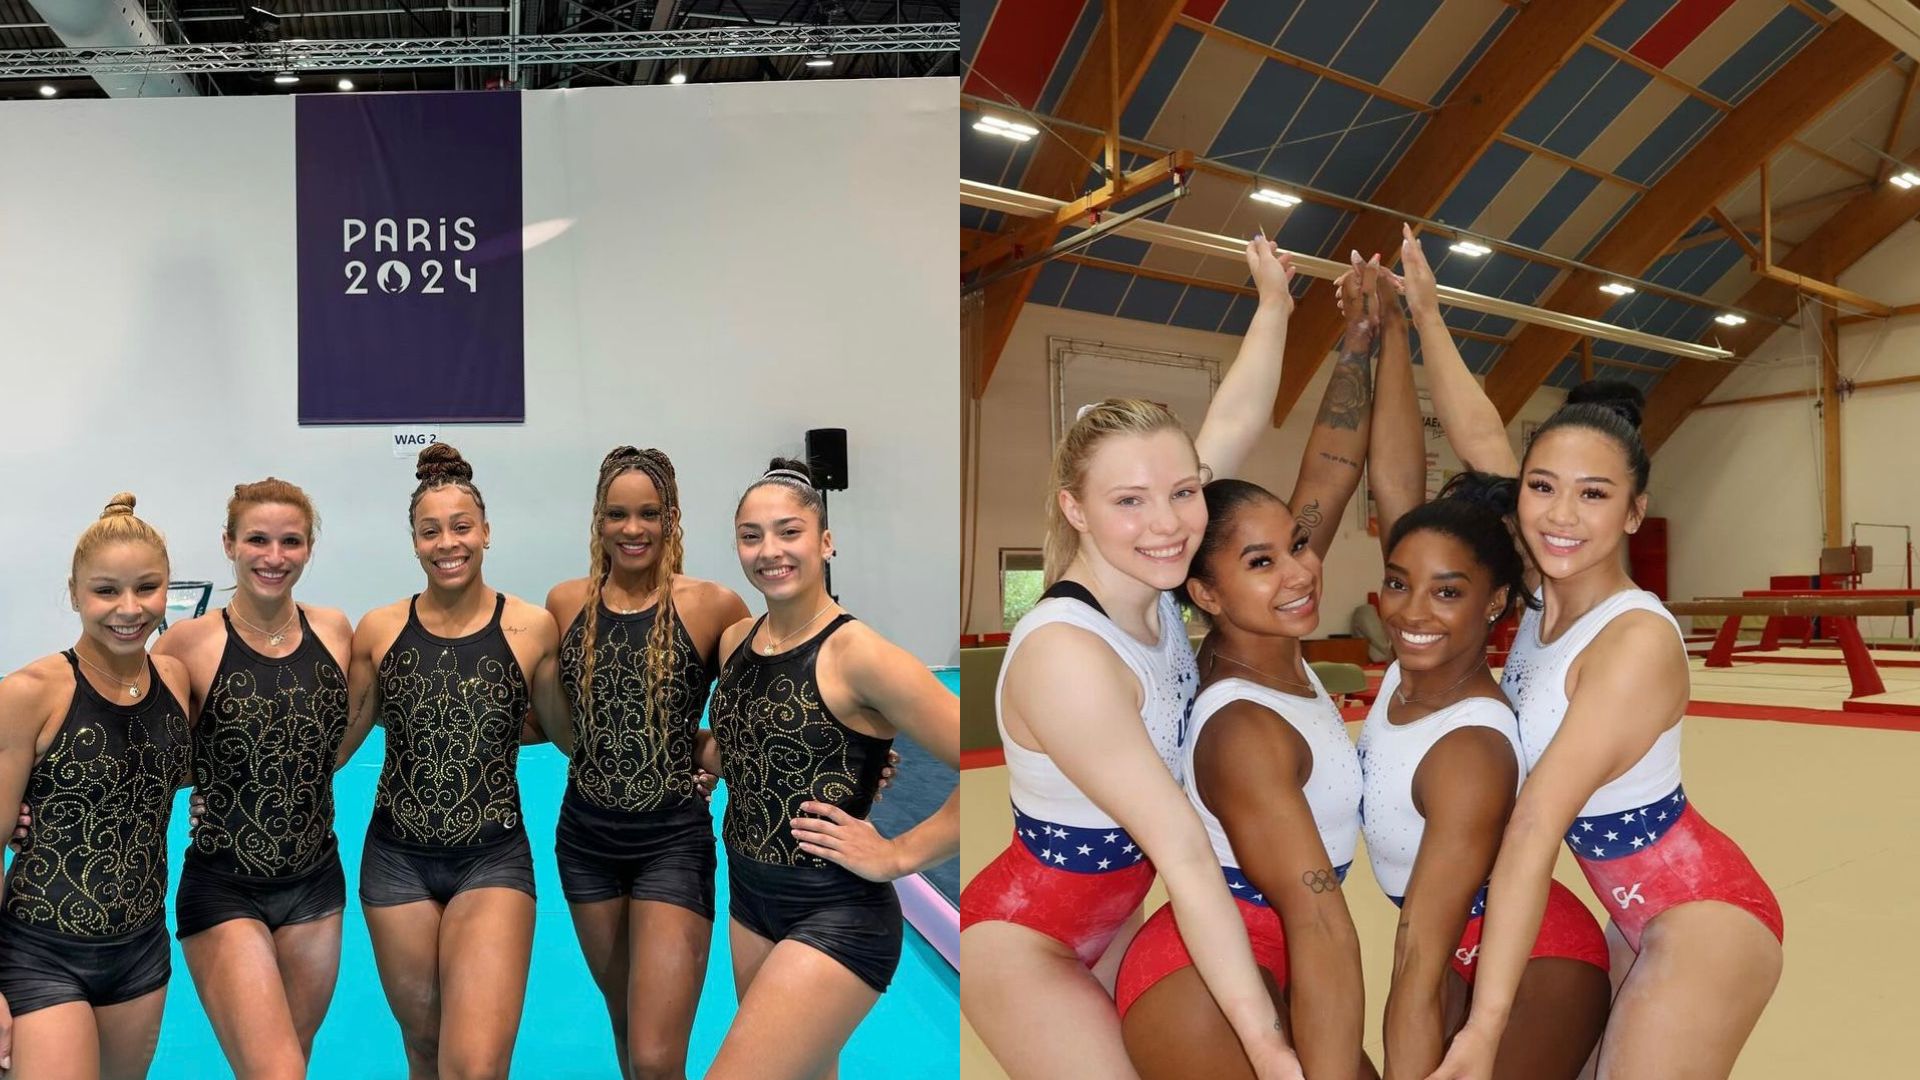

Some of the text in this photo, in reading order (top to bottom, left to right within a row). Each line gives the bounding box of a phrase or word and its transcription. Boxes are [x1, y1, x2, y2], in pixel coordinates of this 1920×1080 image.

[344, 259, 477, 294] 2024
[394, 434, 437, 445] WAG 2
[1611, 882, 1645, 910] GK
